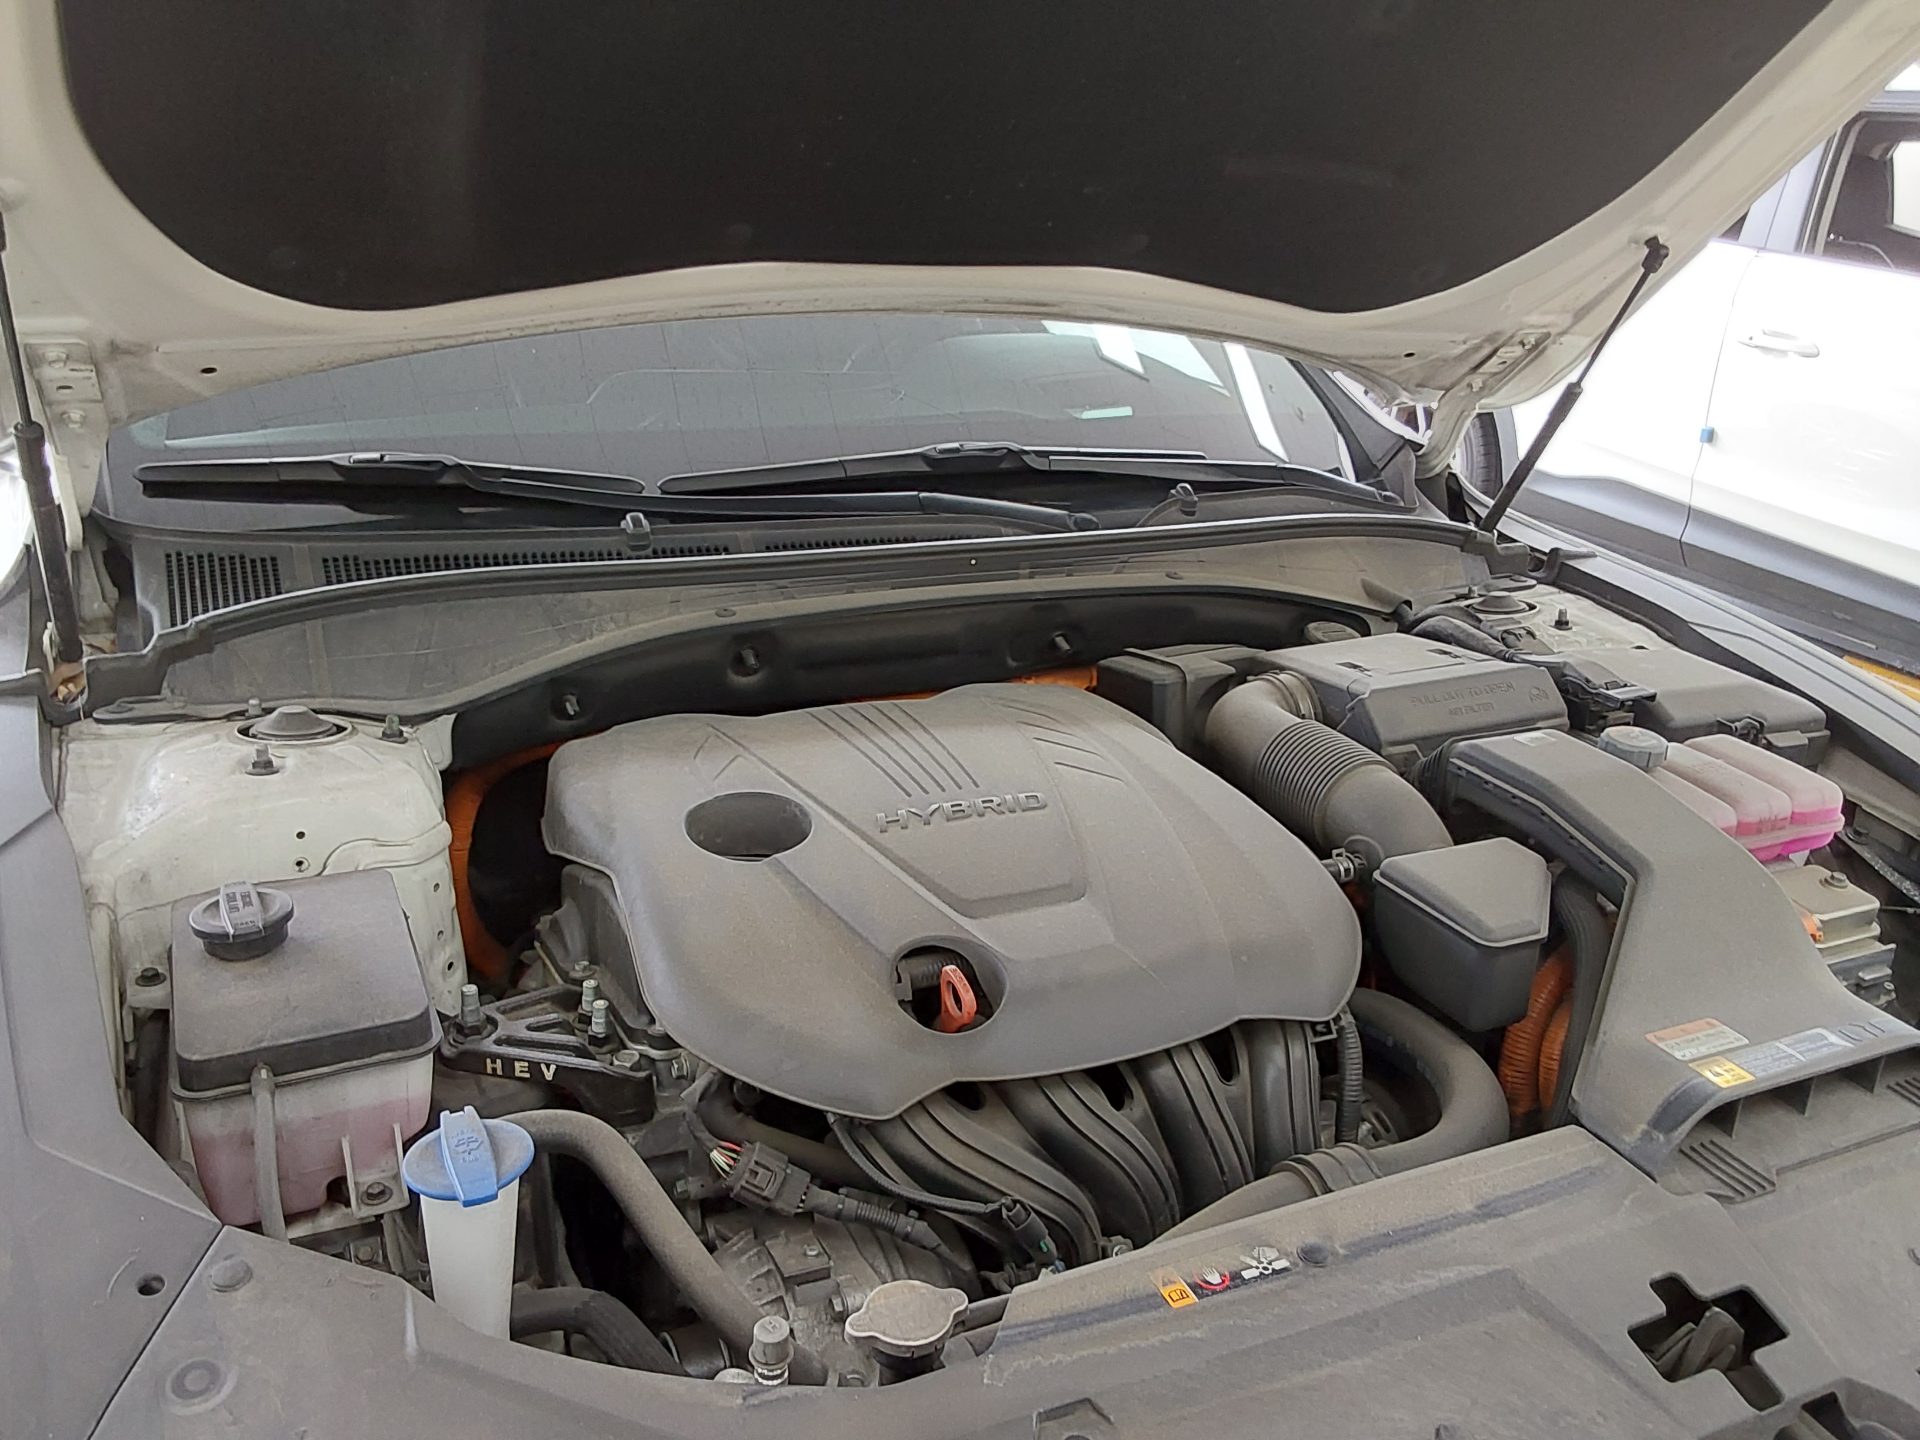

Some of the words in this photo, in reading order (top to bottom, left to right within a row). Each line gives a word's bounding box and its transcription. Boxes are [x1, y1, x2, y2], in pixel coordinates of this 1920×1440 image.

[1465, 686, 1482, 698] TO
[1483, 681, 1516, 695] OPEN
[876, 792, 1048, 833] HYBRID
[485, 1057, 557, 1081] HEV
